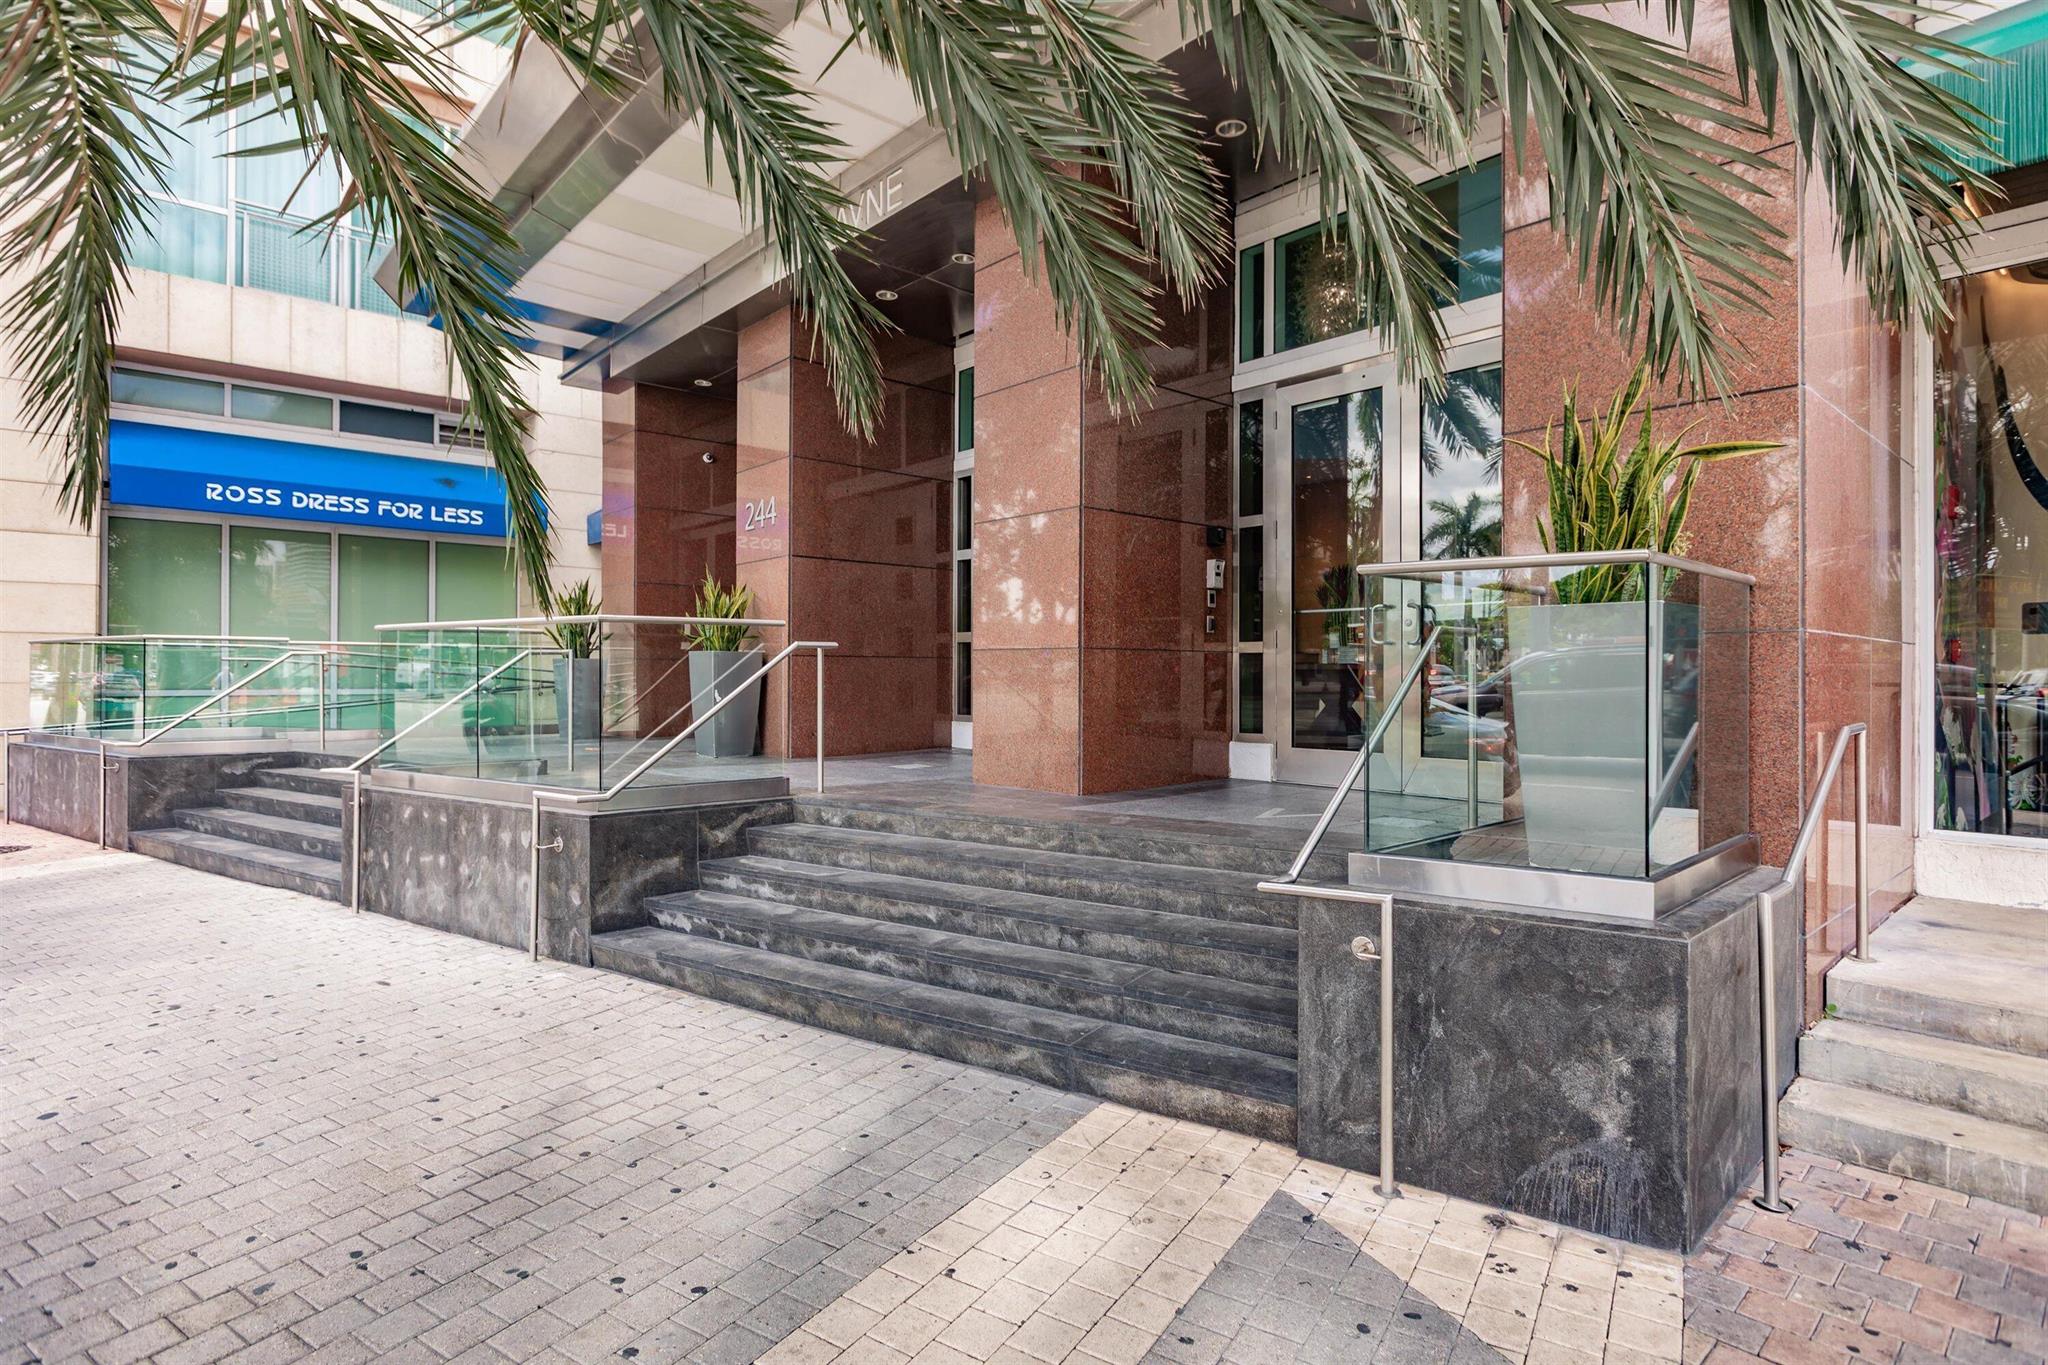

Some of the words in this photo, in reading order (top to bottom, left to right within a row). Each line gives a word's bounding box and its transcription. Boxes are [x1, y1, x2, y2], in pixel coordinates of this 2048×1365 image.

[206, 483, 281, 506] ROSS
[292, 491, 370, 514] DRESS
[378, 501, 423, 519] FOR
[431, 506, 484, 525] LESS
[745, 496, 777, 530] 244
